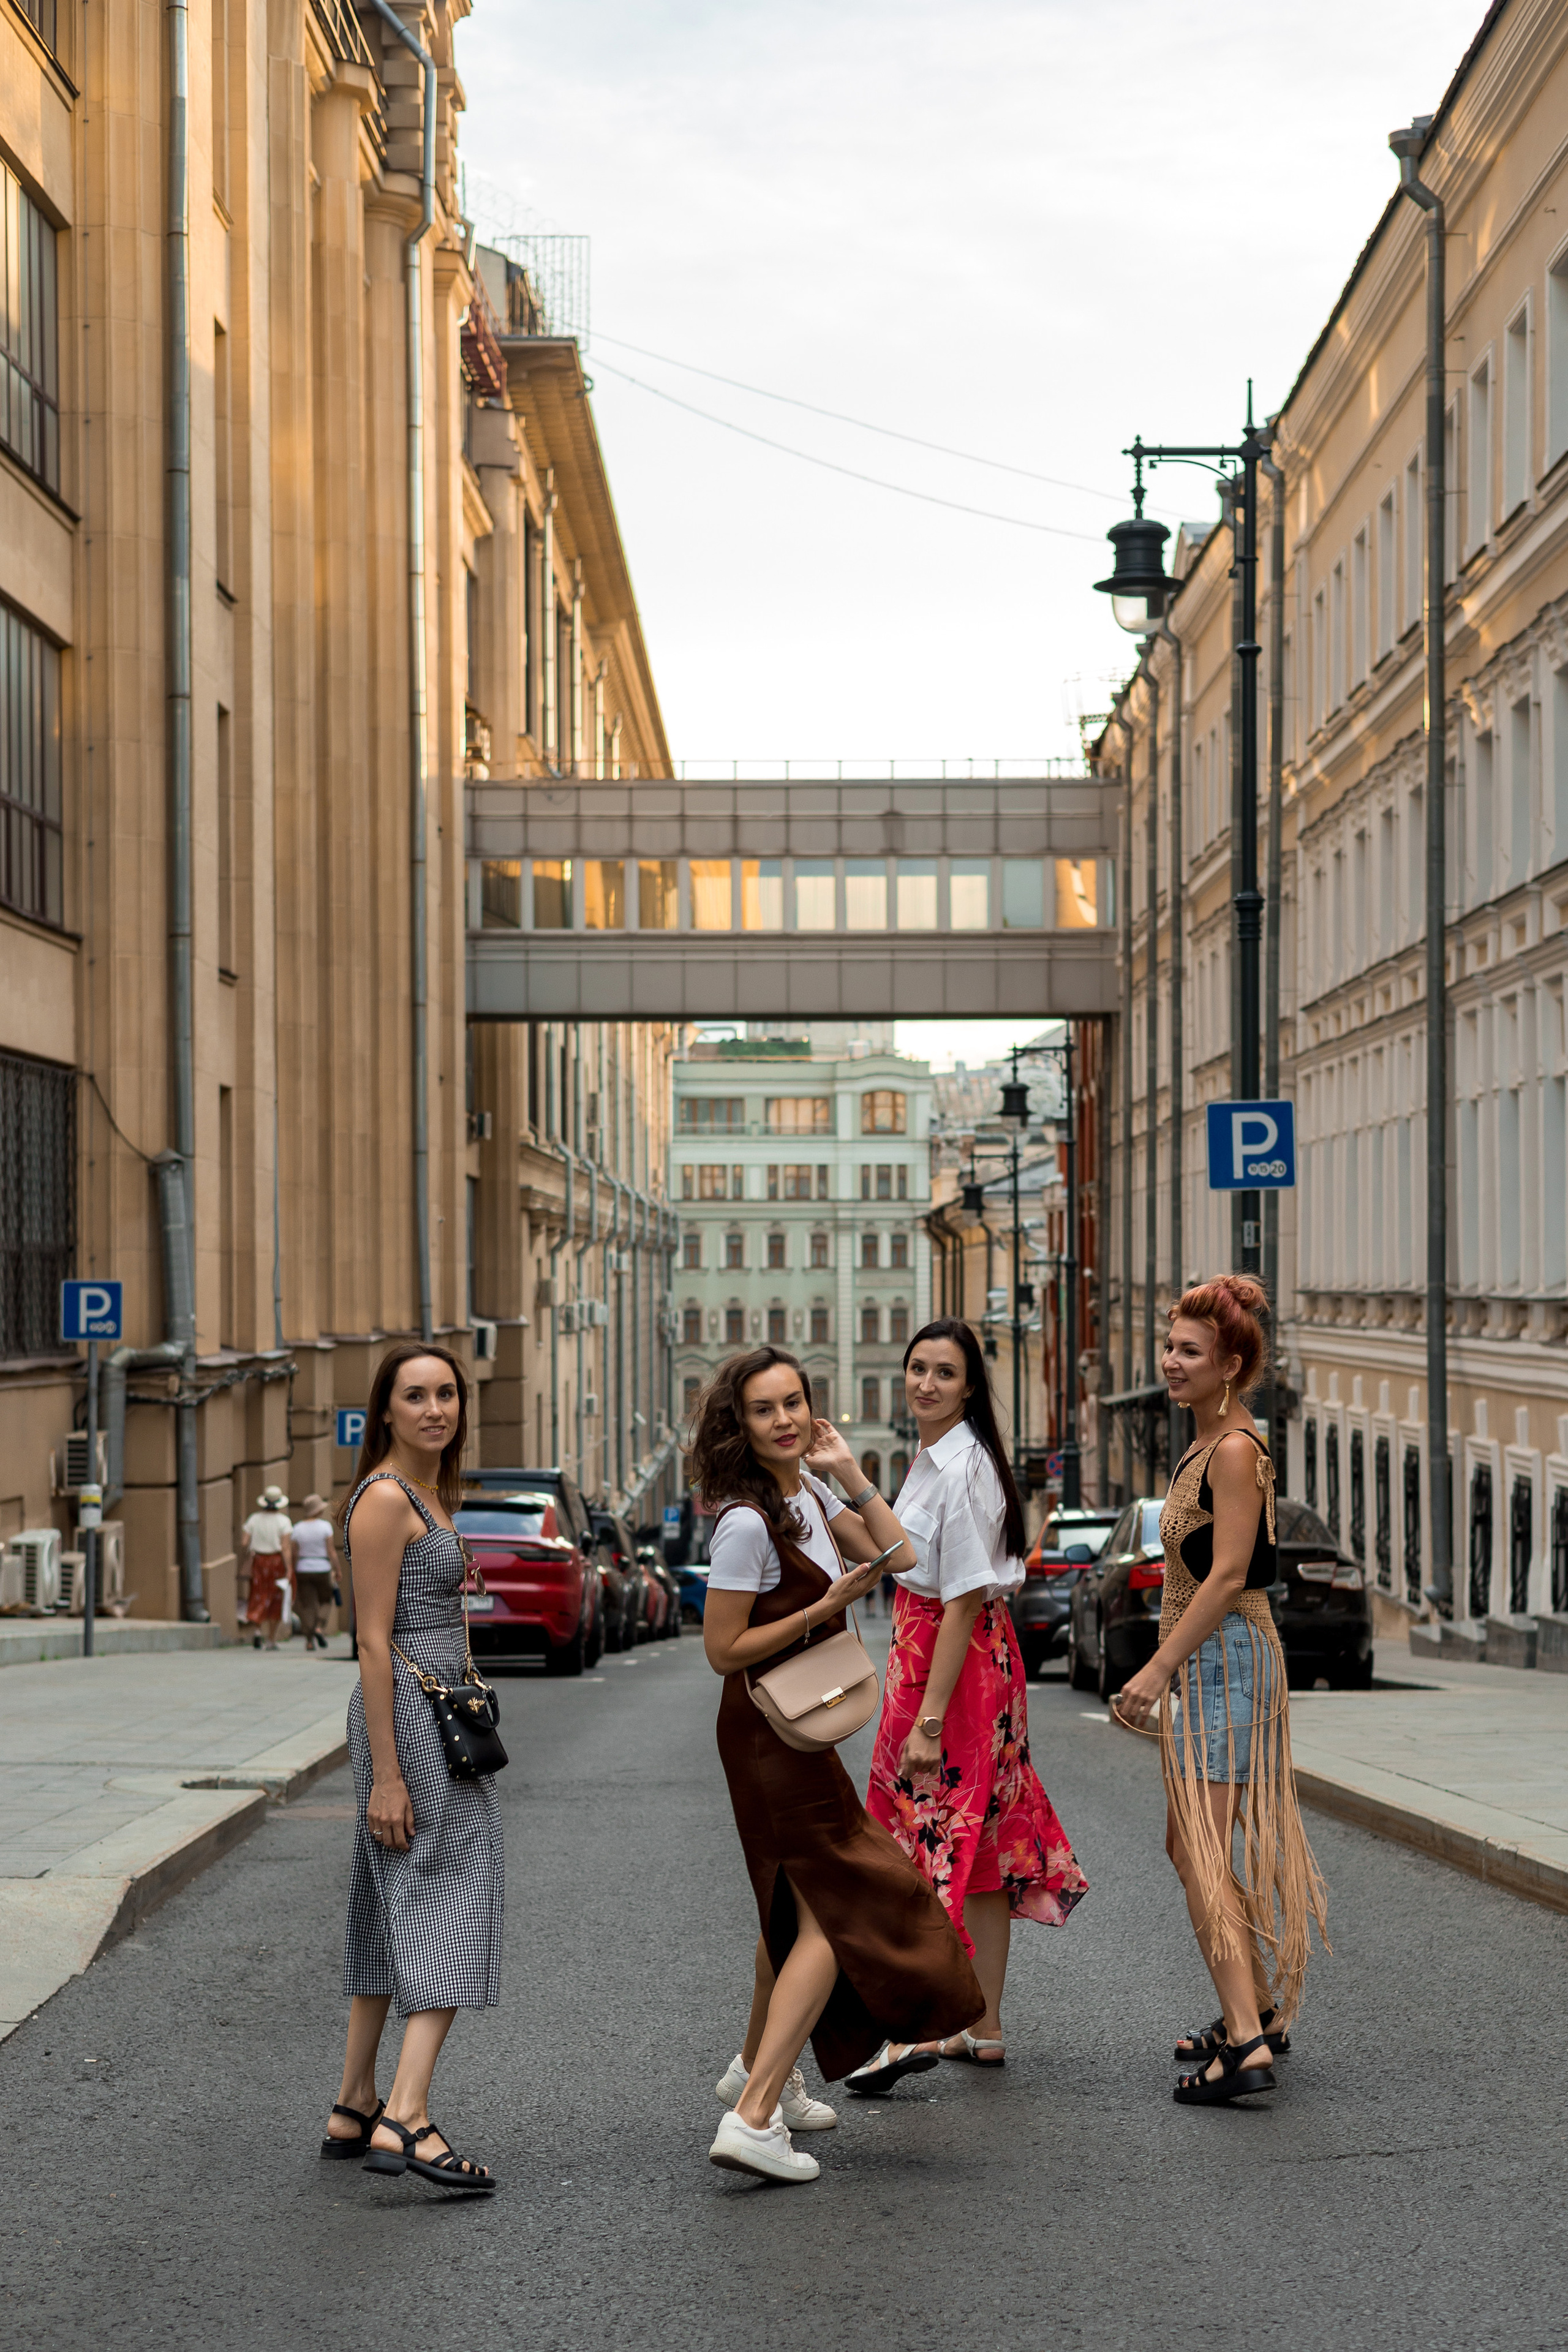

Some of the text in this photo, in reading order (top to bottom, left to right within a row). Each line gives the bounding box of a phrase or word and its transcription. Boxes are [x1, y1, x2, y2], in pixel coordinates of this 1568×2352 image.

[1232, 1112, 1278, 1179] P
[1260, 1164, 1268, 1173] 15
[1271, 1163, 1285, 1174] 20
[79, 1287, 112, 1334] P
[345, 1413, 366, 1443] P
[668, 1507, 678, 1521] P
